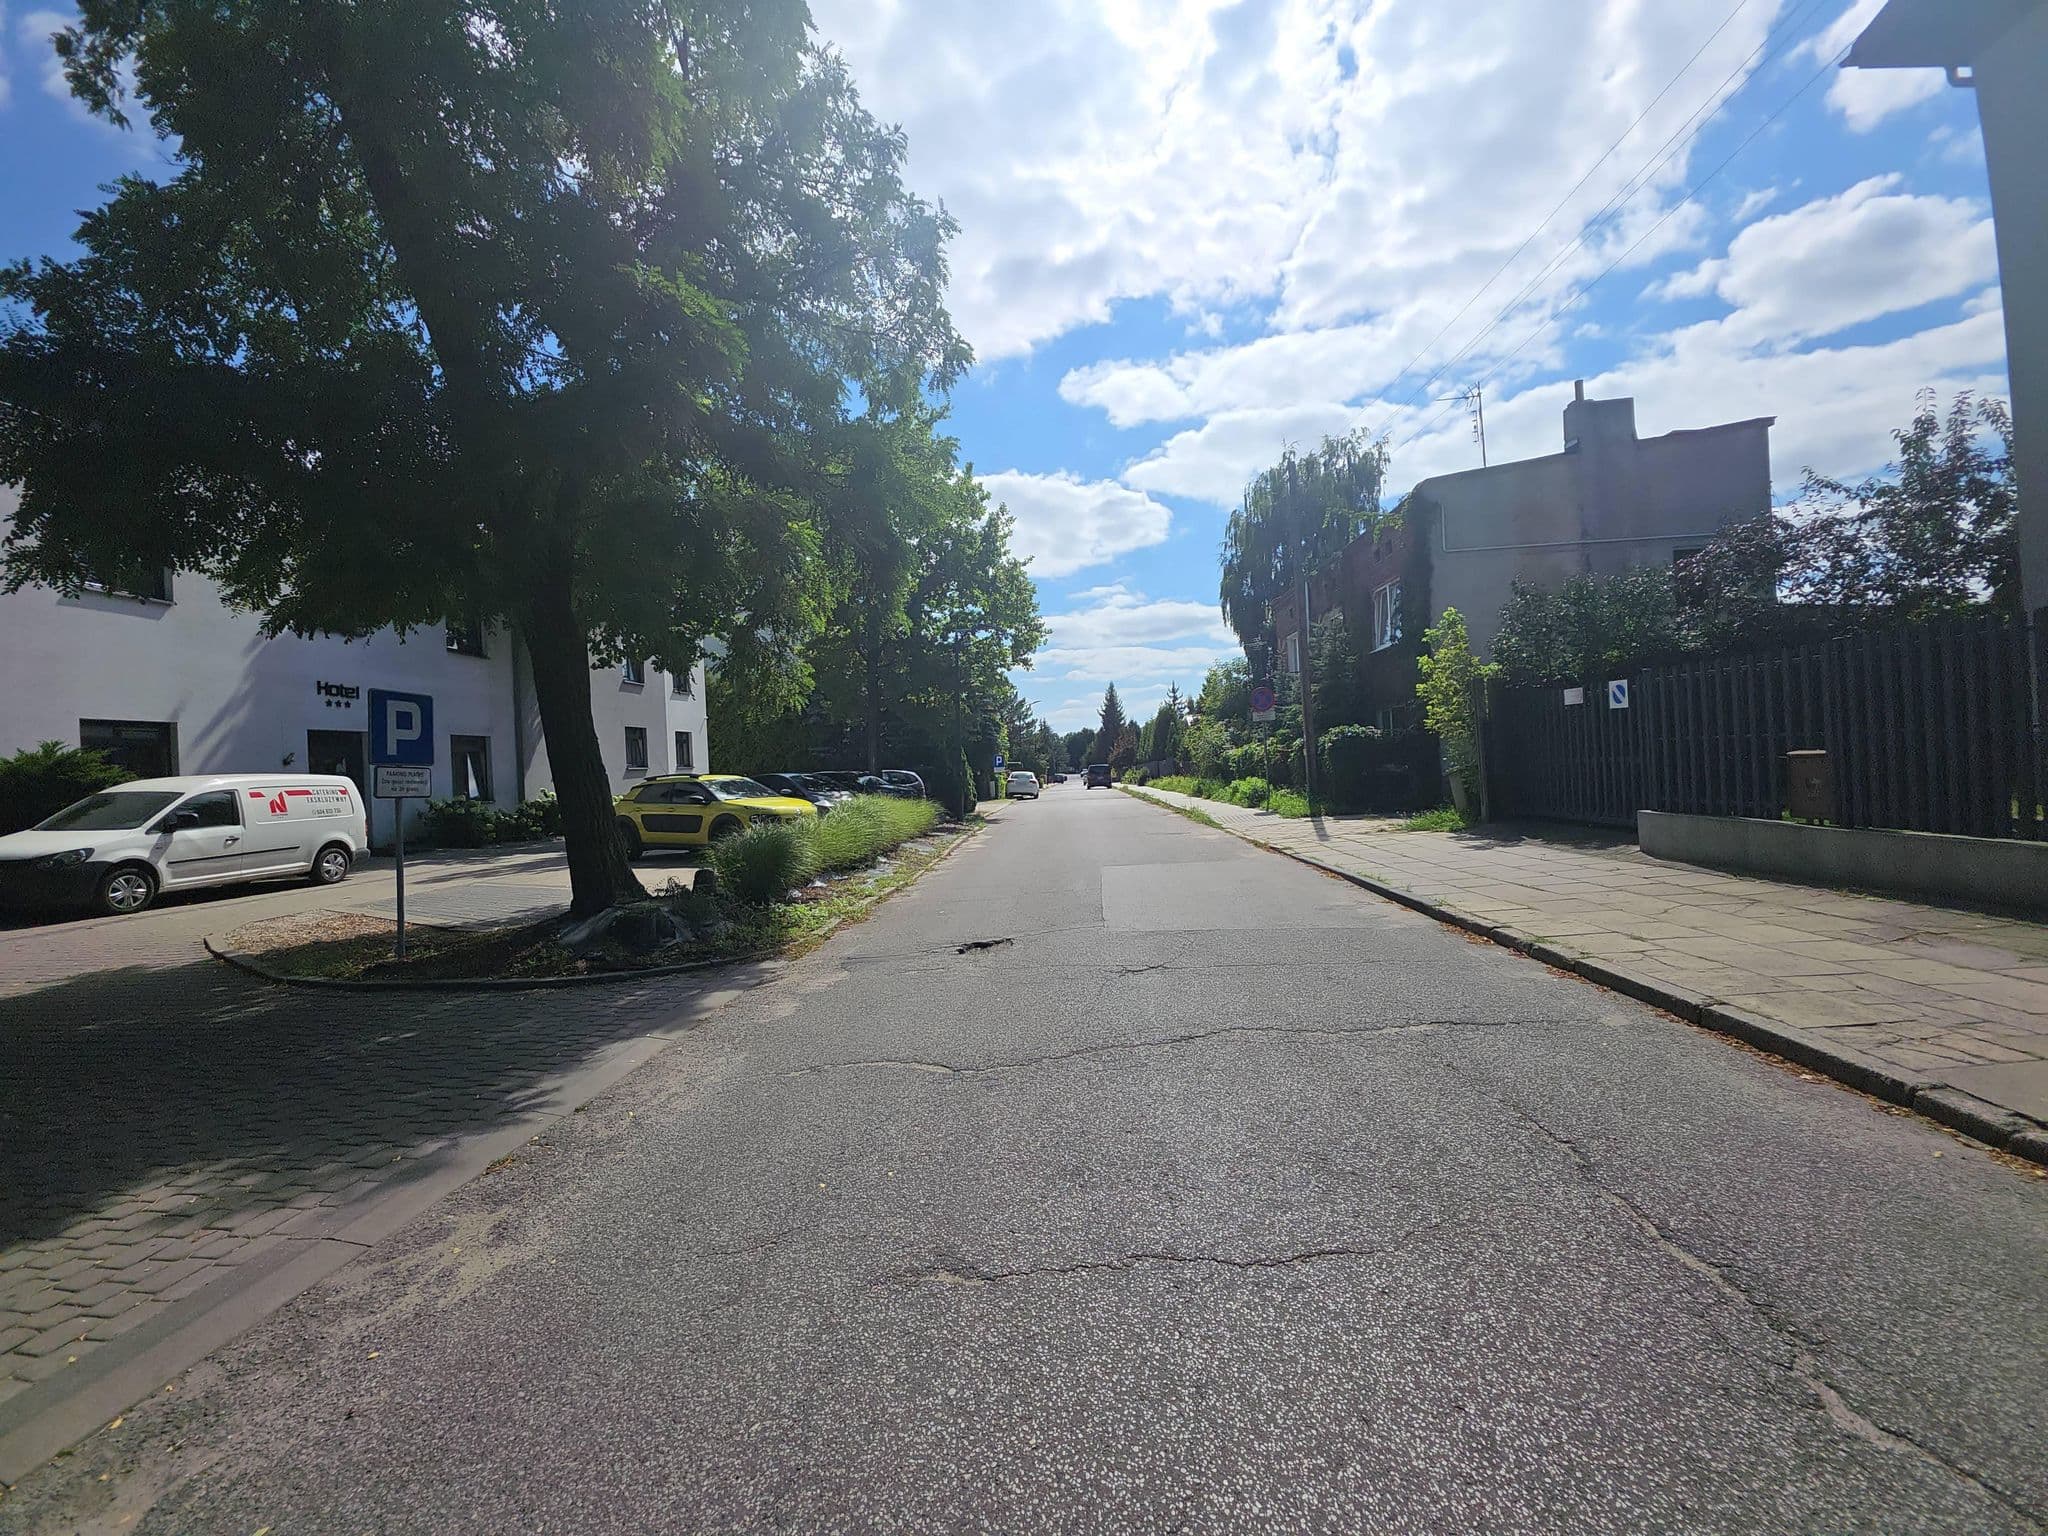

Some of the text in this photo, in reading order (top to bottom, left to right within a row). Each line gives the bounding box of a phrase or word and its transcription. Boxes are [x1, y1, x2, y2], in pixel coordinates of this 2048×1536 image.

[317, 681, 360, 700] Hotel
[386, 700, 421, 755] P
[996, 756, 1003, 766] P
